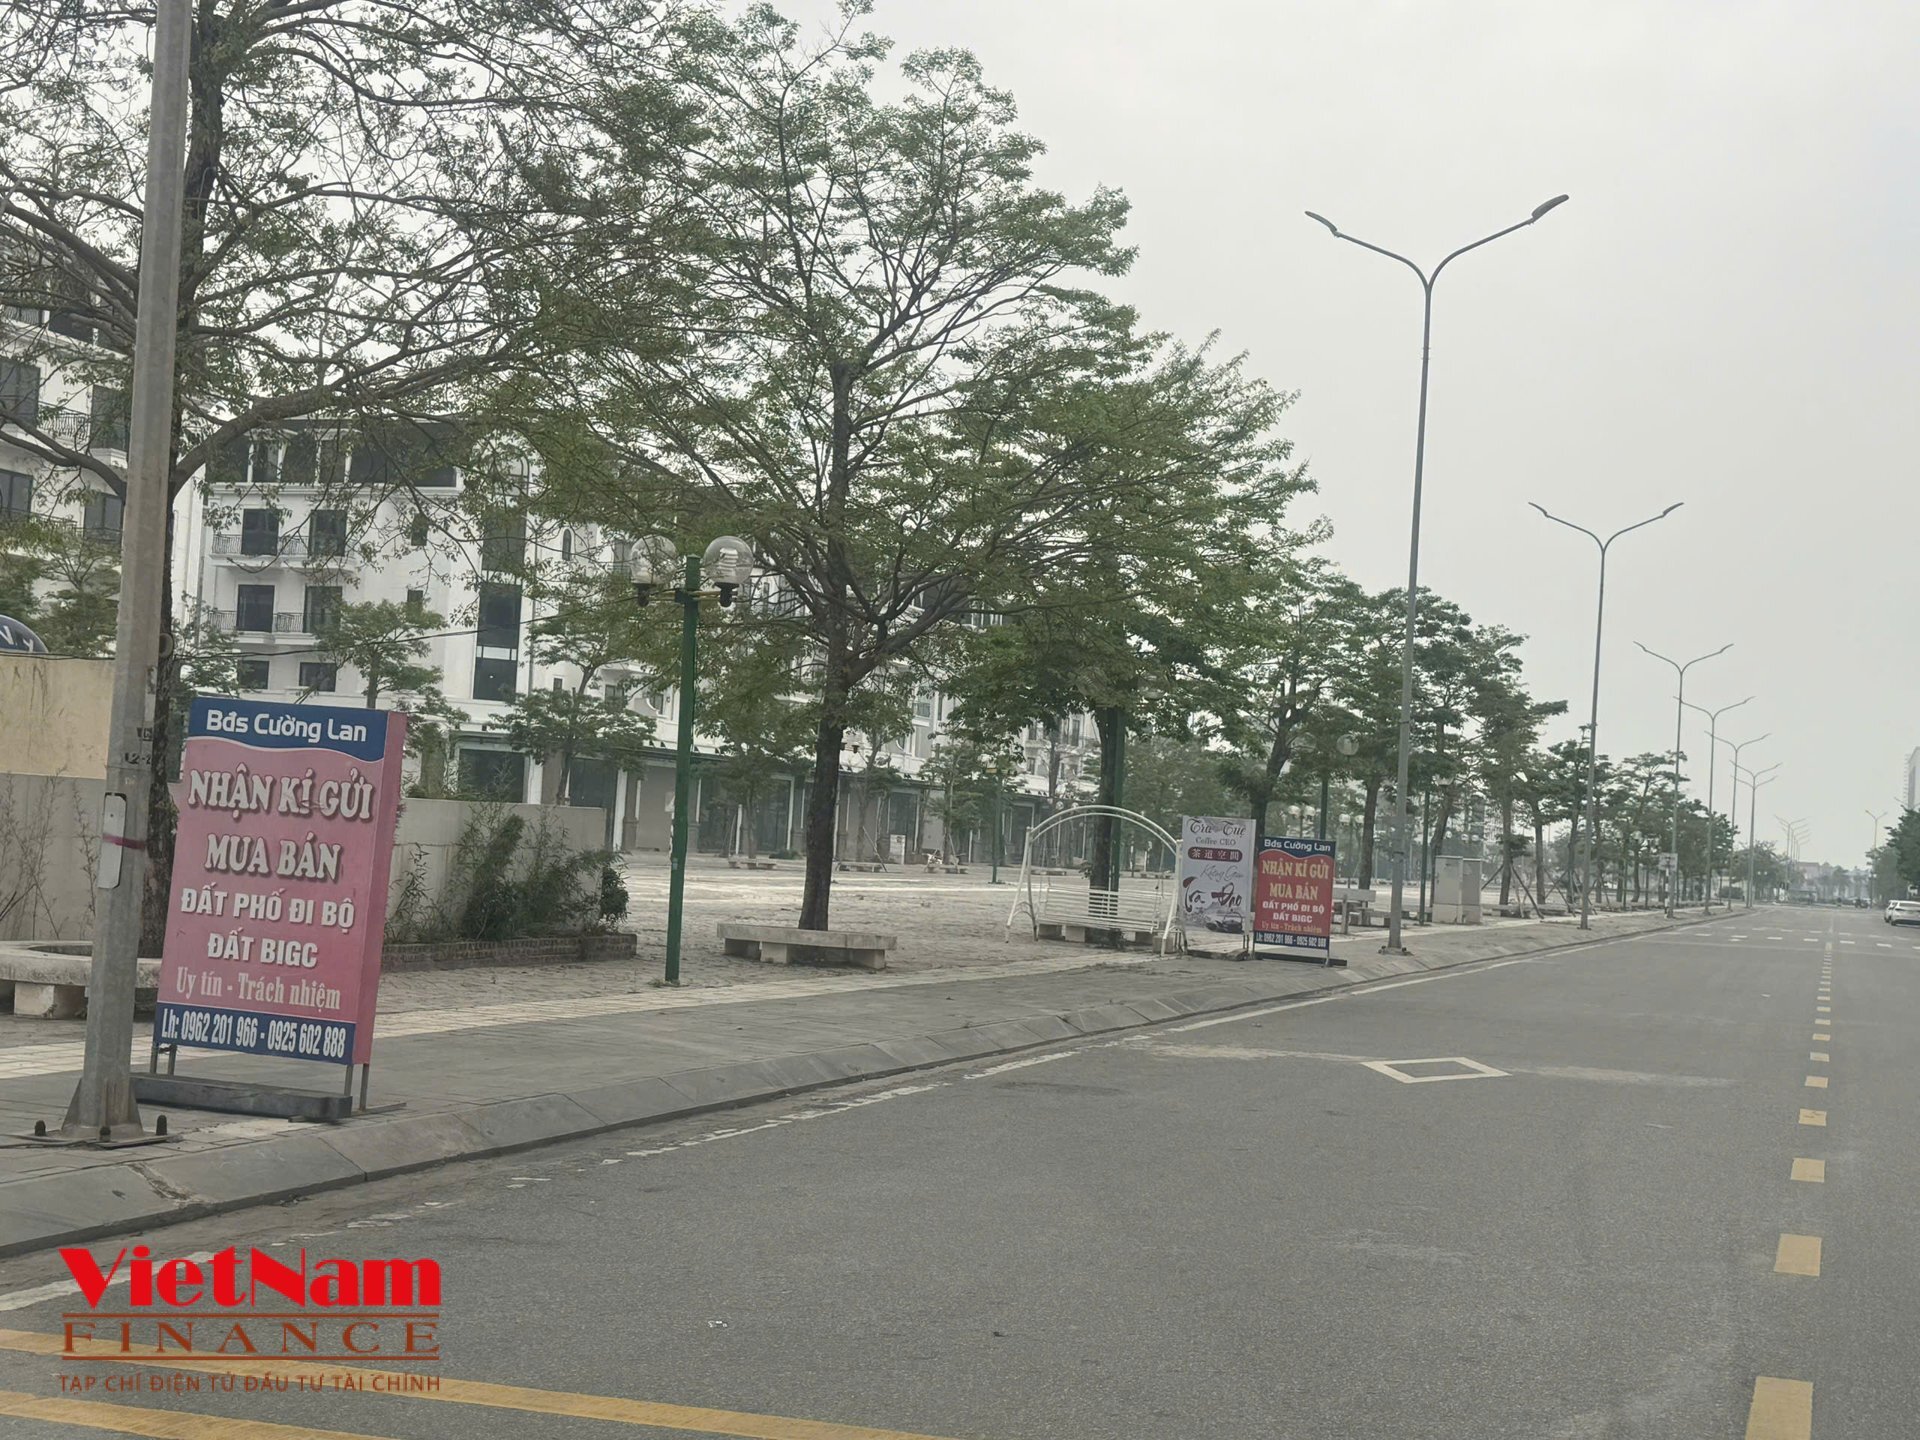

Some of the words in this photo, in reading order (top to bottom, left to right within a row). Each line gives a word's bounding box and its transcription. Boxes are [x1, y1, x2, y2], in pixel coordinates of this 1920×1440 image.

[206, 709, 248, 732] Bđs
[254, 713, 321, 743] Cường
[328, 719, 367, 742] Lan
[188, 763, 272, 819] NHẬN
[278, 768, 312, 815] KÍ
[319, 767, 373, 819] GỬI
[205, 833, 269, 874] MUA
[277, 832, 341, 880] BÁN
[1264, 839, 1282, 848] Bđs
[1283, 841, 1312, 852] Cường
[1314, 843, 1331, 852] Lan
[1262, 858, 1293, 880] NHẬN
[1295, 860, 1307, 877] KÍ
[1309, 859, 1329, 880] GỬI
[181, 883, 227, 916] ĐẤT
[233, 888, 285, 921] PHỐ
[289, 898, 313, 924] ĐI
[321, 898, 354, 933] BỘ
[1269, 883, 1293, 899] MUA
[1295, 882, 1319, 901] BÁN
[1291, 914, 1313, 923] BIGC
[207, 928, 254, 961] ĐẤT
[260, 938, 318, 968] BIGC
[176, 966, 196, 999] Uy
[200, 970, 222, 997] tín
[238, 972, 285, 1004] Trách
[289, 979, 341, 1013] nhiệm
[161, 1008, 179, 1039] Lh:
[181, 1010, 209, 1042] 0962
[211, 1013, 233, 1045] 201
[235, 1016, 258, 1047] 966
[267, 1019, 298, 1052] 0925
[299, 1023, 321, 1055] 602
[324, 1025, 346, 1058] 888
